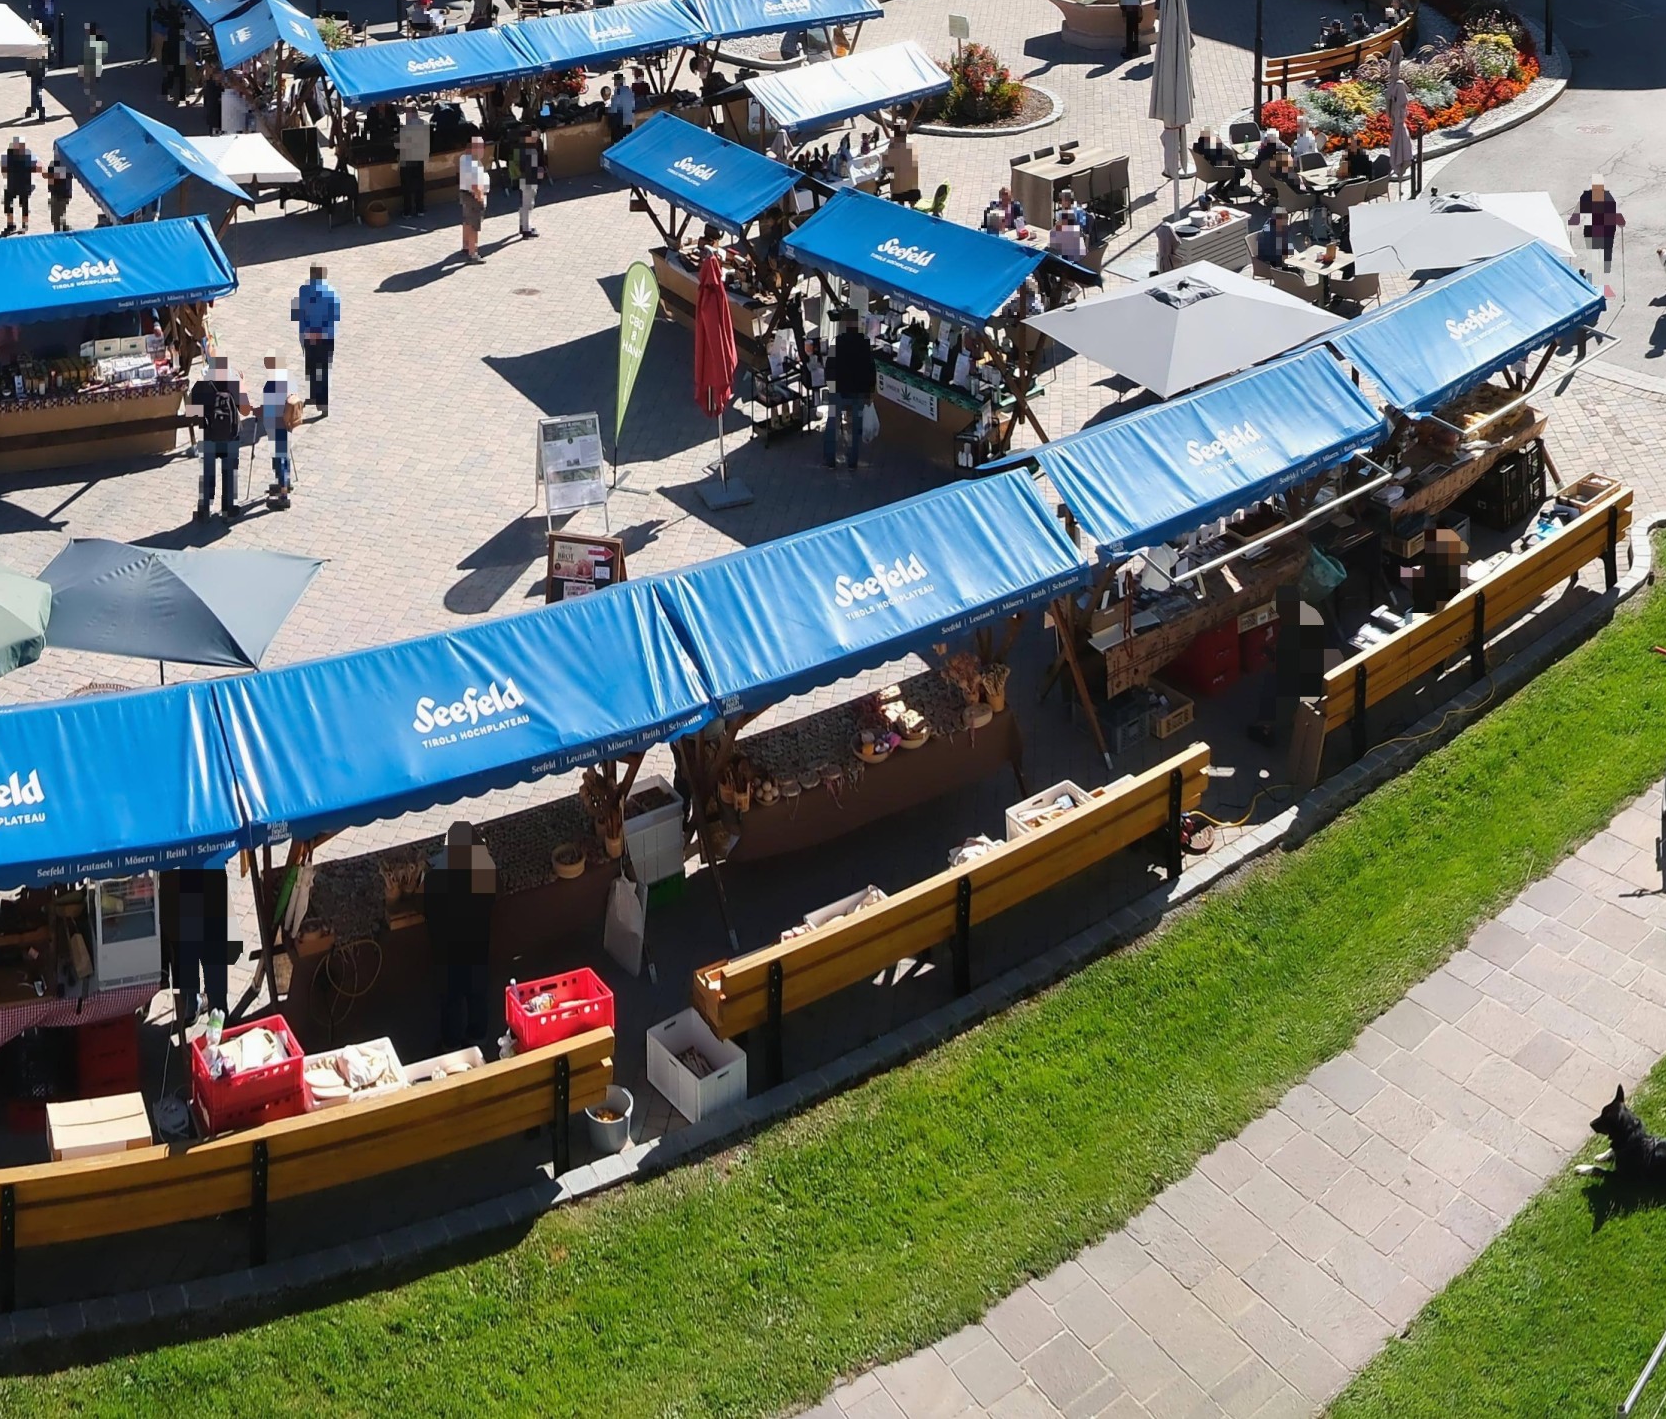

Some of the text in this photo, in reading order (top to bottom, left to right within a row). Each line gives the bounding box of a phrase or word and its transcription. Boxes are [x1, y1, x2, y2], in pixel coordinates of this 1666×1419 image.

[407, 55, 456, 73] Seefeld
[673, 156, 717, 182] Seefeld
[48, 257, 119, 284] Seefeld
[876, 237, 936, 267] Seefeld
[629, 313, 645, 331] CBD
[1445, 299, 1503, 341] Seefeld
[1185, 420, 1262, 467] Seefeld
[834, 551, 930, 608] Seefeld
[845, 584, 935, 622] TIROLS HOCHPLATEAU
[412, 677, 526, 734] Seefeld
[422, 714, 530, 749] TIROLS HOCHPLATEAU
[531, 759, 556, 774] Seefeld
[565, 748, 598, 765] Leutasch
[607, 738, 633, 753] Mösern
[642, 728, 661, 742] Reith
[37, 838, 236, 878] Seefeld Leutasch Mösern Reith Scharnitz
